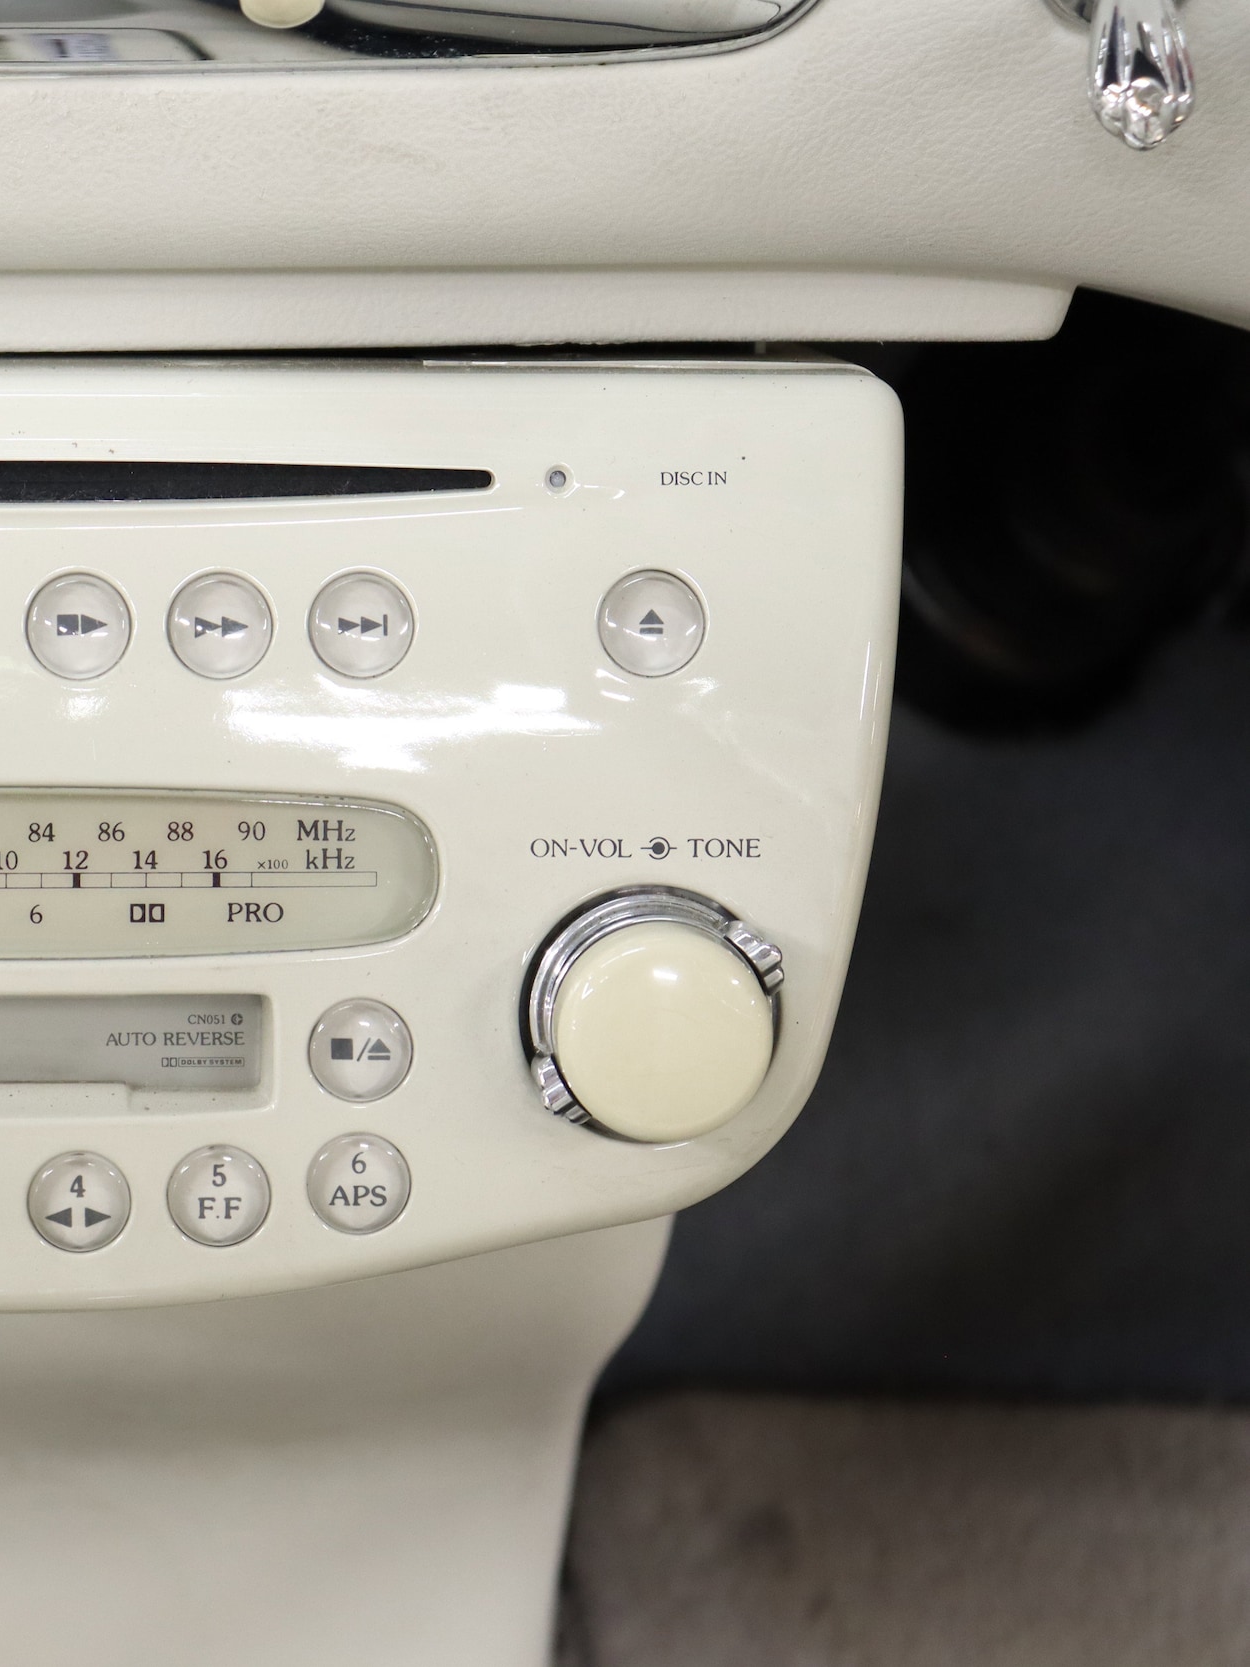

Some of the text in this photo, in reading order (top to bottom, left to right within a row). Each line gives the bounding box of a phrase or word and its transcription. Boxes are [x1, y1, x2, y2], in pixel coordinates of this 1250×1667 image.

[660, 471, 727, 486] DISC IN
[28, 822, 56, 843] 84
[97, 821, 125, 842] 86
[167, 821, 194, 842] 88
[237, 821, 266, 841] 90
[296, 819, 356, 842] MHz
[530, 838, 761, 858] ON-VOL TONE
[63, 850, 89, 870] 12
[132, 849, 159, 870] 14
[202, 849, 228, 870] 16
[305, 849, 355, 870] kHz
[29, 904, 43, 924] 6
[227, 902, 284, 923] PRO
[187, 1014, 225, 1025] CN051
[105, 1031, 246, 1047] AUTO REVERSE
[180, 1058, 243, 1066] DOLBY SYSTEM
[351, 1151, 367, 1175] 6
[69, 1174, 86, 1198] 4
[211, 1163, 227, 1188] 5
[328, 1185, 388, 1208] APS
